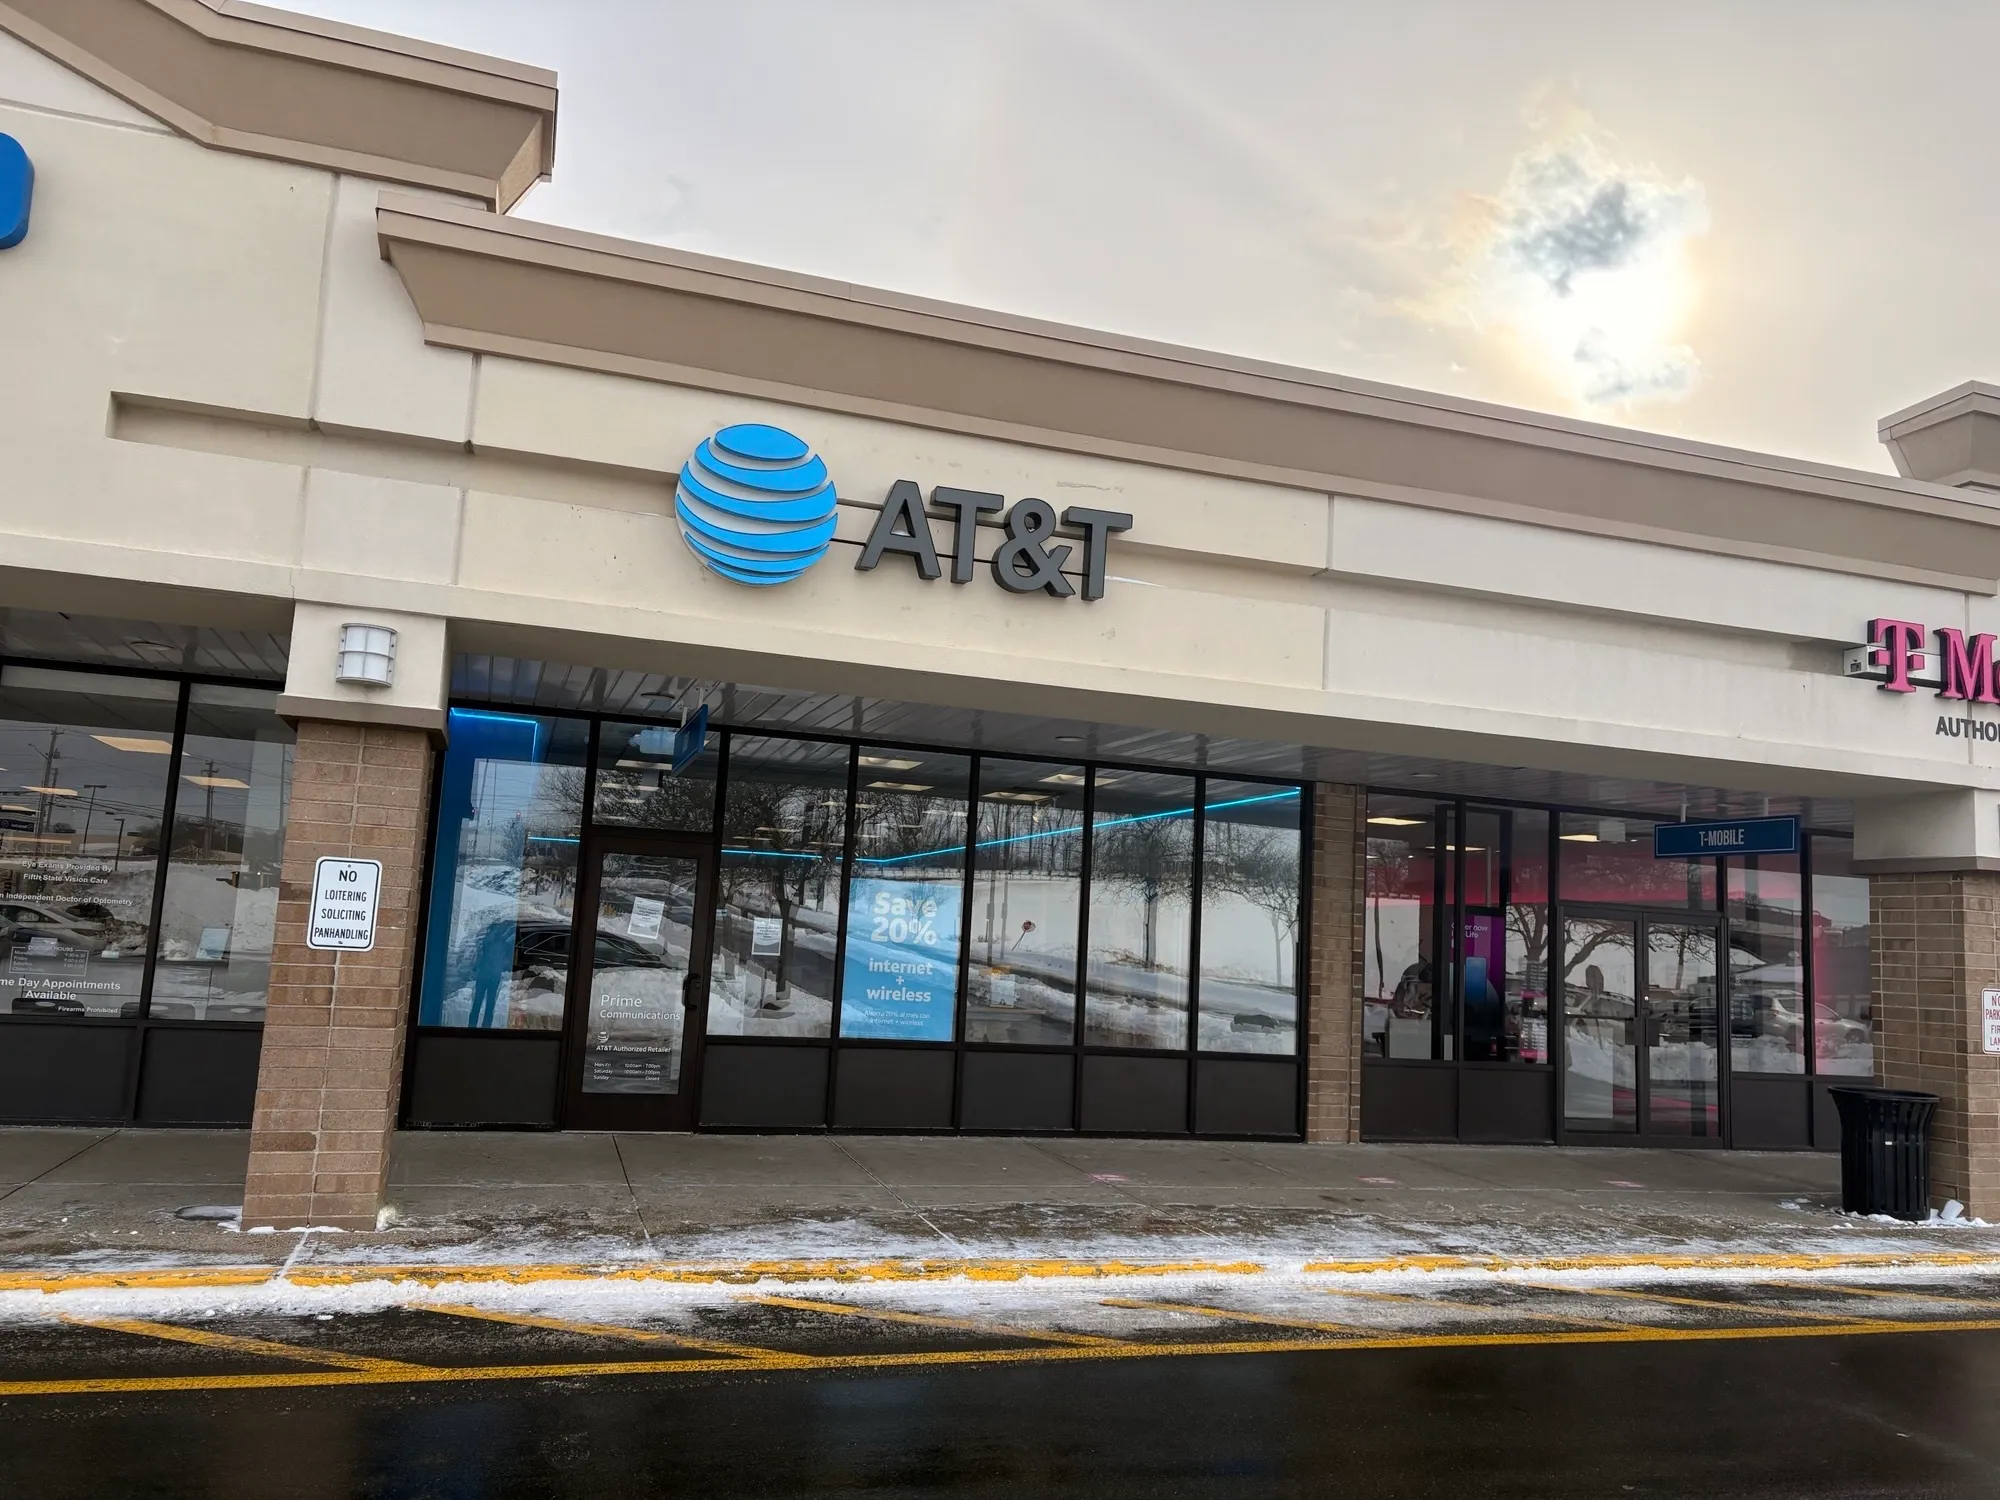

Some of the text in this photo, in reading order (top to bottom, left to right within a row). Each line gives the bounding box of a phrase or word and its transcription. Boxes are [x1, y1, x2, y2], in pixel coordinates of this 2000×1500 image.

[855, 480, 1133, 601] AT&T
[1933, 627, 2000, 704] M
[1936, 716, 2000, 742] AUTHO
[1699, 828, 1744, 847] T-MOBILE
[339, 870, 357, 882] NO
[6, 893, 54, 901] Independent
[93, 897, 133, 906] Optometry
[325, 890, 367, 902] LOITERING
[873, 892, 937, 917] Save
[321, 908, 366, 921] SOLICITING
[314, 927, 369, 940] PANHANDLING
[870, 916, 937, 945] 20%
[868, 958, 933, 975] internet
[18, 977, 40, 989] Day
[42, 978, 121, 990] Appointments
[25, 990, 77, 1001] Available
[866, 986, 932, 1002] wireless
[601, 995, 642, 1007] Prime
[600, 1009, 681, 1020] Communications
